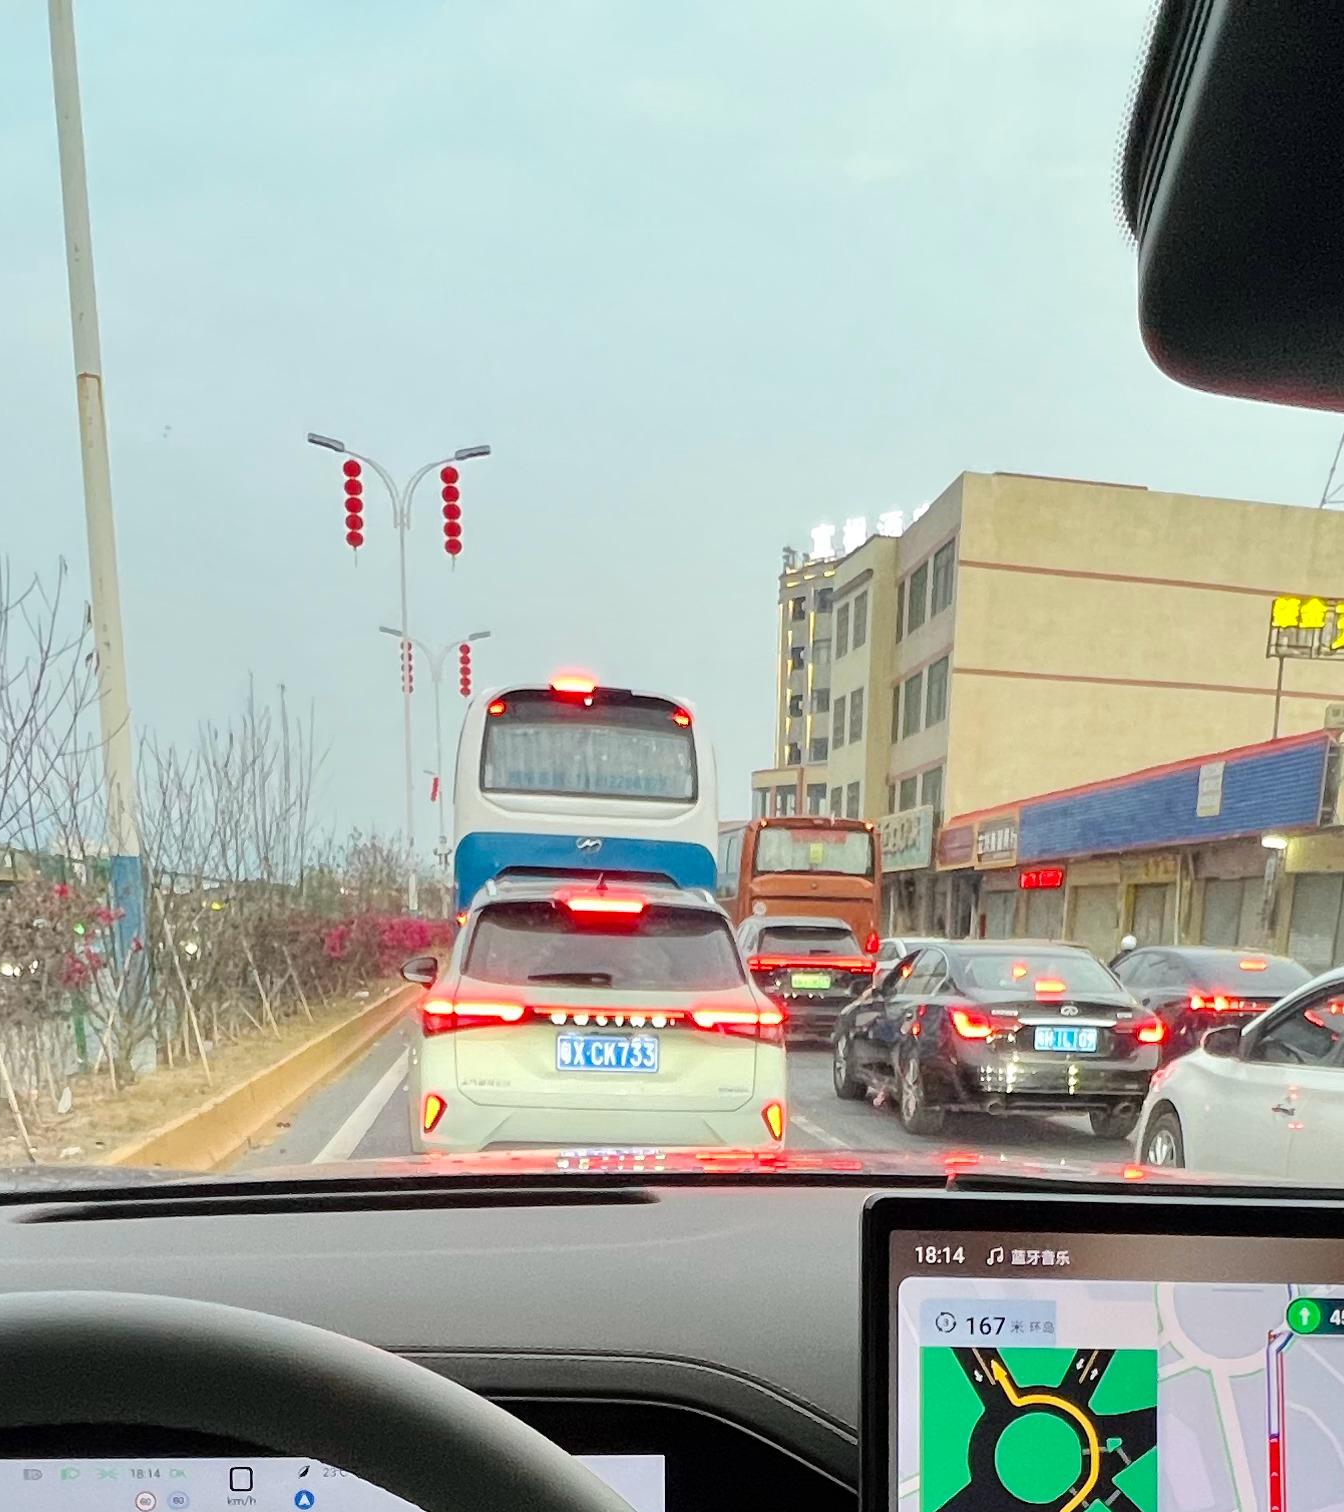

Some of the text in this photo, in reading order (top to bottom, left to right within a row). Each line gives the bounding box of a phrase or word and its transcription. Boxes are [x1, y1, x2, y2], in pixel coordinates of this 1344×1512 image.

[915, 1246, 965, 1264] 18:14
[1011, 1249, 1071, 1266] 蓝牙音乐
[966, 1316, 1006, 1335] 167
[130, 1468, 161, 1479] 18:14
